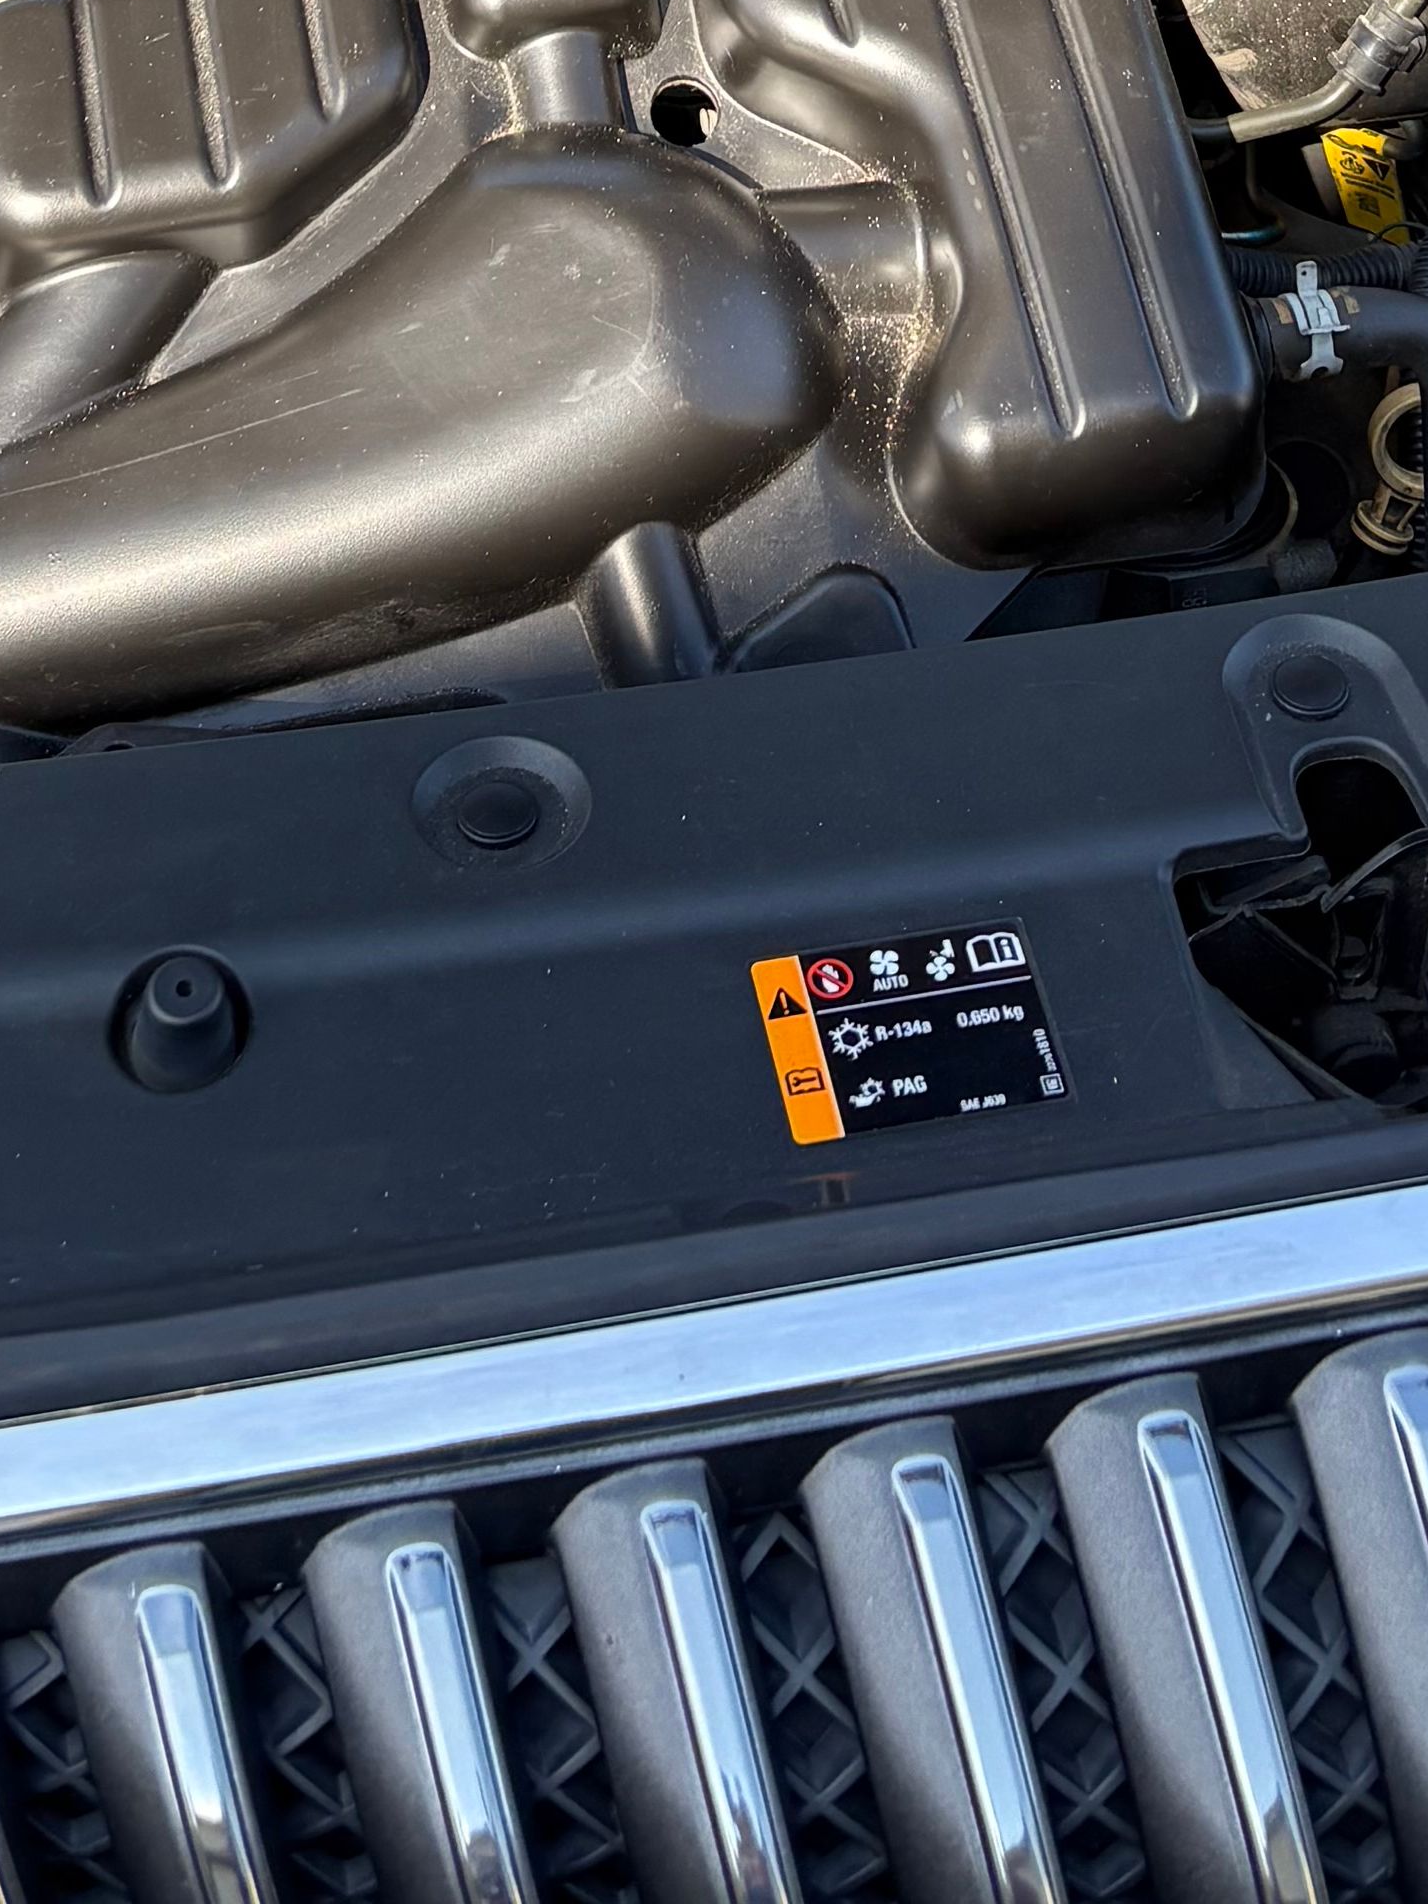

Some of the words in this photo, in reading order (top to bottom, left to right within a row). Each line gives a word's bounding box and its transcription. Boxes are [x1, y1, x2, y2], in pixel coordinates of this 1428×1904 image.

[872, 974, 909, 993] AUTO
[874, 1019, 933, 1042] R-134a
[956, 1006, 1000, 1029] 0.650
[1002, 1003, 1025, 1023] kg
[891, 1075, 928, 1097] PAG
[959, 1097, 981, 1113] SAE
